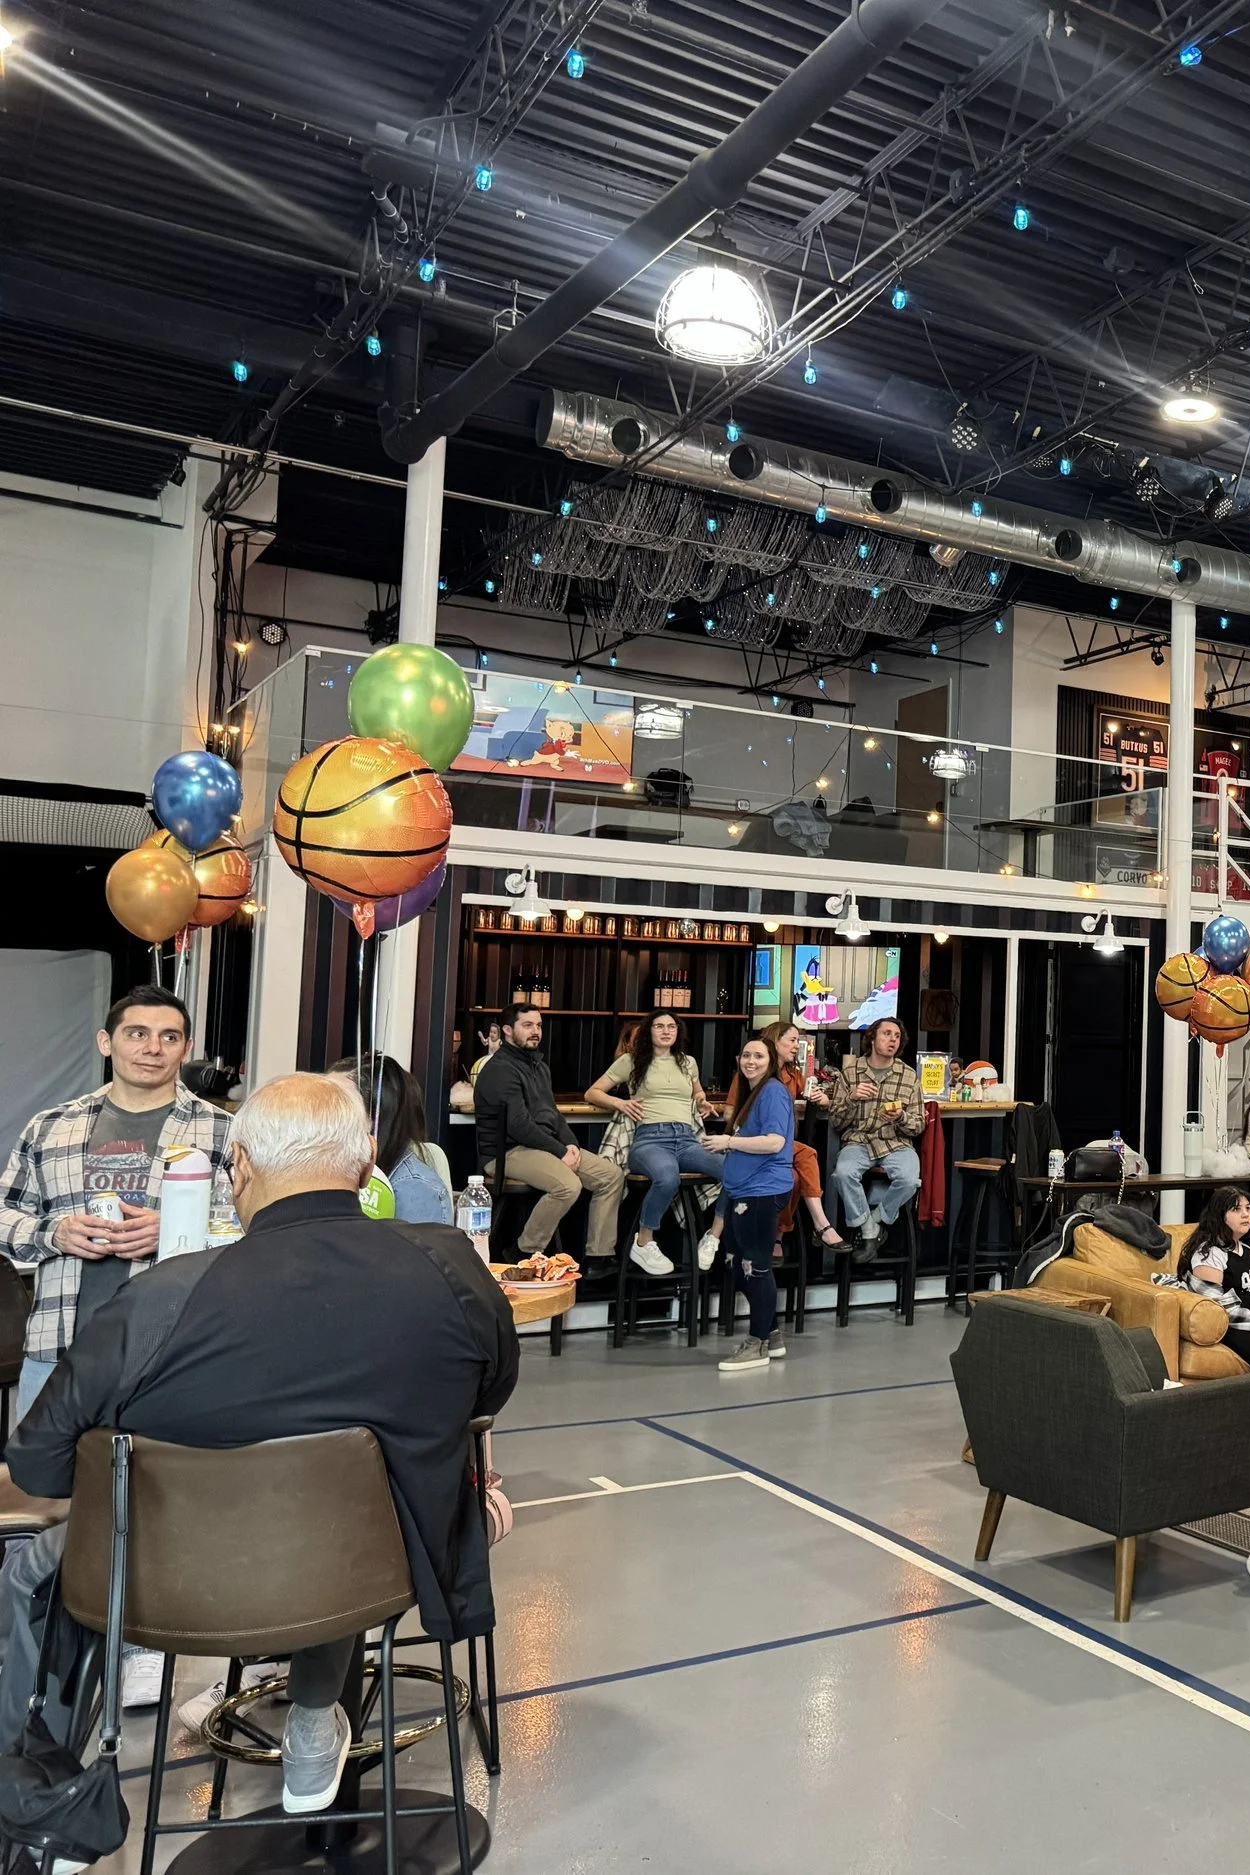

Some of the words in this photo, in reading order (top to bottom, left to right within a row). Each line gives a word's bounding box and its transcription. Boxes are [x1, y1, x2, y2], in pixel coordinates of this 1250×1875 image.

[1103, 733, 1114, 747] 51
[1120, 739, 1149, 754] BUTKUS
[1153, 740, 1164, 754] 51
[1215, 757, 1232, 767] MAGEE
[1121, 756, 1145, 793] 51
[1116, 870, 1148, 885] CORVO
[1191, 875, 1202, 887] 10
[84, 1172, 150, 1191] LORID
[359, 1188, 379, 1209] SA
